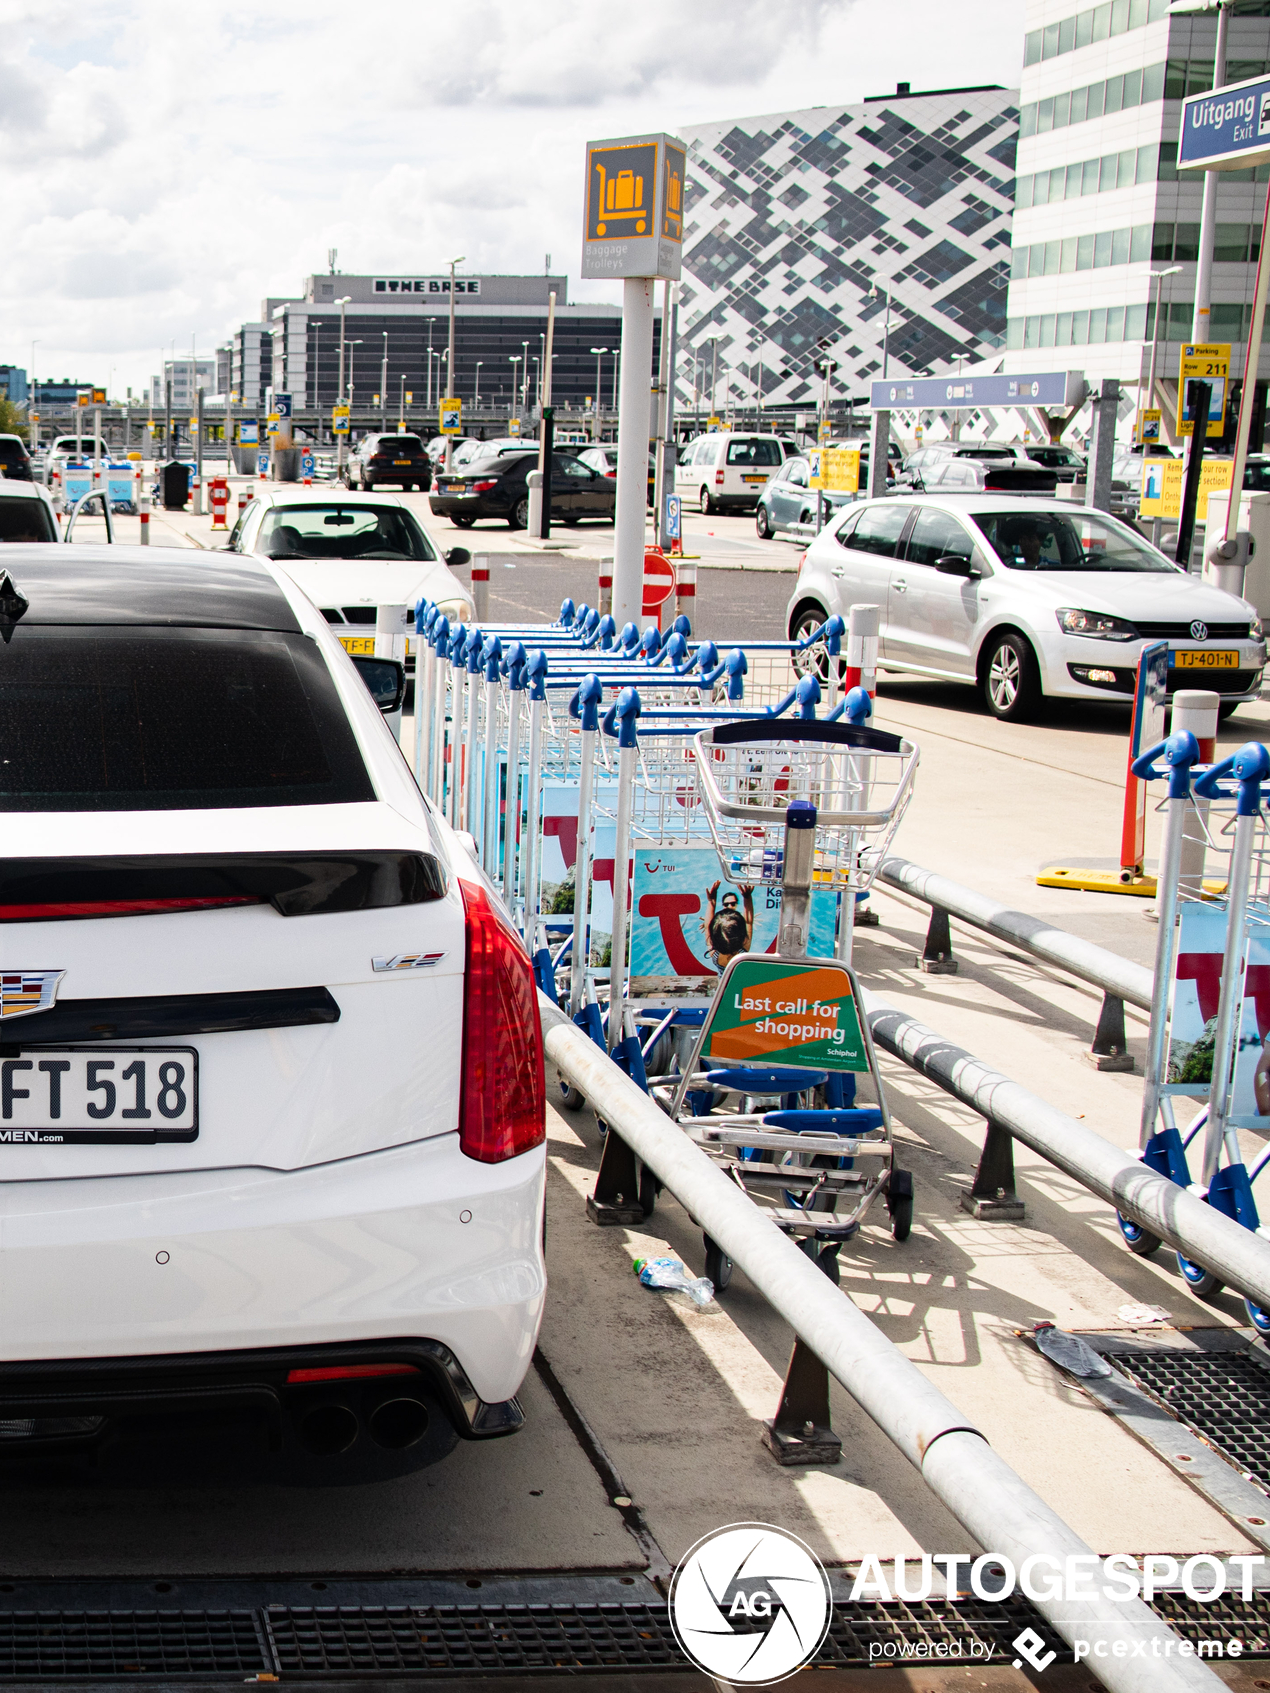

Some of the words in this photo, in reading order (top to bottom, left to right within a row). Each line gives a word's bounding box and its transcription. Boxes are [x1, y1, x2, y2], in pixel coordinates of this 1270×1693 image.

[1192, 95, 1256, 130] Uitgang
[1233, 123, 1254, 142] Exit
[585, 245, 628, 257] Baggage
[585, 259, 623, 270] Trolleys
[388, 280, 425, 292] THE
[429, 280, 479, 293] BASE
[1195, 348, 1219, 356] Parking
[1205, 363, 1227, 375] 211
[1203, 477, 1228, 486] section!
[1181, 653, 1232, 666] TJ-401-N
[734, 993, 772, 1013] Last
[775, 998, 807, 1015] call
[812, 1000, 841, 1018] for
[755, 1017, 845, 1044] shopping
[827, 1048, 857, 1058] Schiphol
[1, 1060, 71, 1119] FT
[86, 1060, 187, 1119] 518
